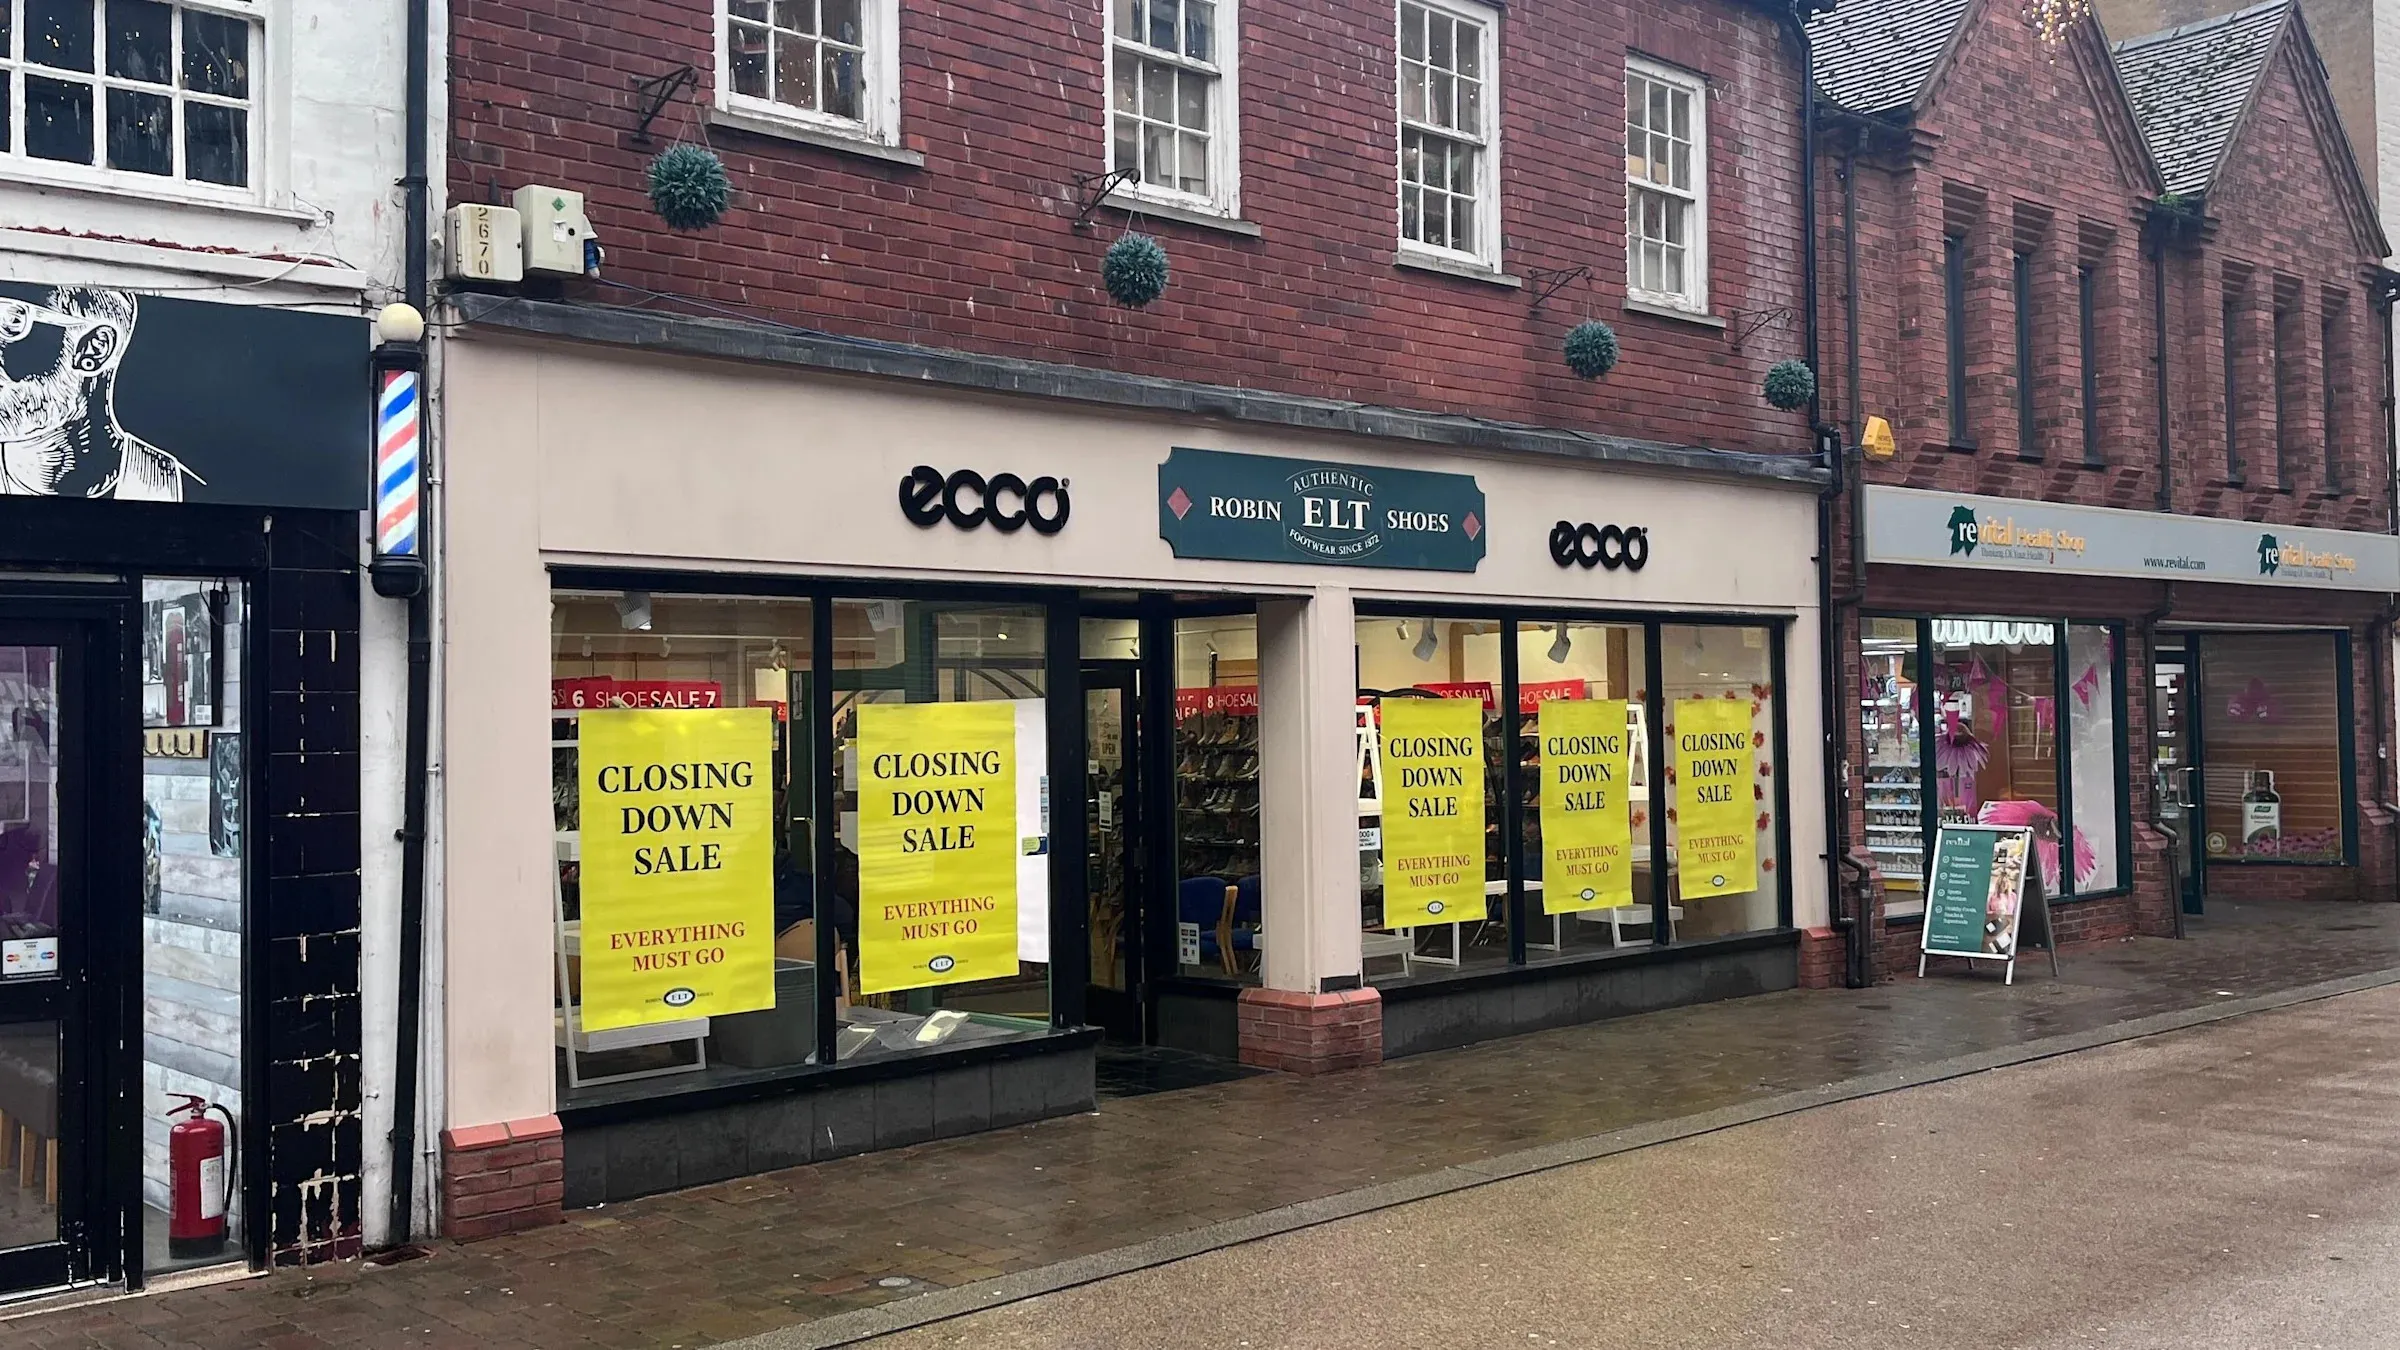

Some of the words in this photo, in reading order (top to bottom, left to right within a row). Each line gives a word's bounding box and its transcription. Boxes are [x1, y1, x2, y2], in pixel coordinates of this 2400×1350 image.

[478, 207, 489, 275] 2670
[1293, 471, 1374, 497] AUTHENTIC
[899, 465, 1069, 536] ecco
[1209, 495, 1282, 522] ROBIN
[1302, 496, 1371, 530] ELT
[1386, 509, 1449, 533] SHOES
[1289, 528, 1336, 555] FOOTWEAR
[1338, 542, 1363, 555] SINCE
[1549, 520, 1648, 572] ecco
[2017, 527, 2054, 549] Health
[2057, 530, 2086, 558] Shop
[2143, 555, 2206, 571] www.revital.com
[572, 690, 585, 708] 6
[704, 690, 716, 708] 7
[1207, 694, 1214, 709] 8
[1240, 693, 1259, 707] SAL
[1519, 691, 1542, 705] HOE
[1390, 737, 1473, 758] CLOSING
[1548, 735, 1619, 756] CLOSING
[1682, 732, 1745, 752] CLOSING
[873, 750, 1001, 779] CLOSING
[1559, 763, 1612, 784] DOWN
[1692, 758, 1738, 778] DOWN
[598, 761, 753, 794] CLOSING
[1401, 767, 1463, 788] DOWN
[892, 787, 985, 816] DOWN
[1565, 791, 1606, 812] SALE
[1697, 784, 1733, 804] SALE
[1408, 796, 1458, 818] SALE
[621, 802, 734, 834] DOWN
[902, 825, 975, 853] SALE
[1688, 834, 1744, 850] EVERYTHING
[634, 843, 721, 875] SALE
[1397, 854, 1471, 871] EVERYTHING
[1556, 845, 1619, 861] EVERYTHING
[1698, 851, 1721, 864] MUST
[1722, 850, 1736, 862] GO
[1566, 862, 1594, 876] MUST
[1595, 861, 1609, 874] GO
[1409, 873, 1442, 888] MUST
[1443, 872, 1459, 885] GO
[883, 896, 995, 921] EVERYTHING
[610, 922, 745, 950] EVERYTHING
[901, 922, 949, 941] MUST
[953, 919, 978, 935] GO
[632, 950, 691, 972] MUST
[696, 947, 725, 965] GO
